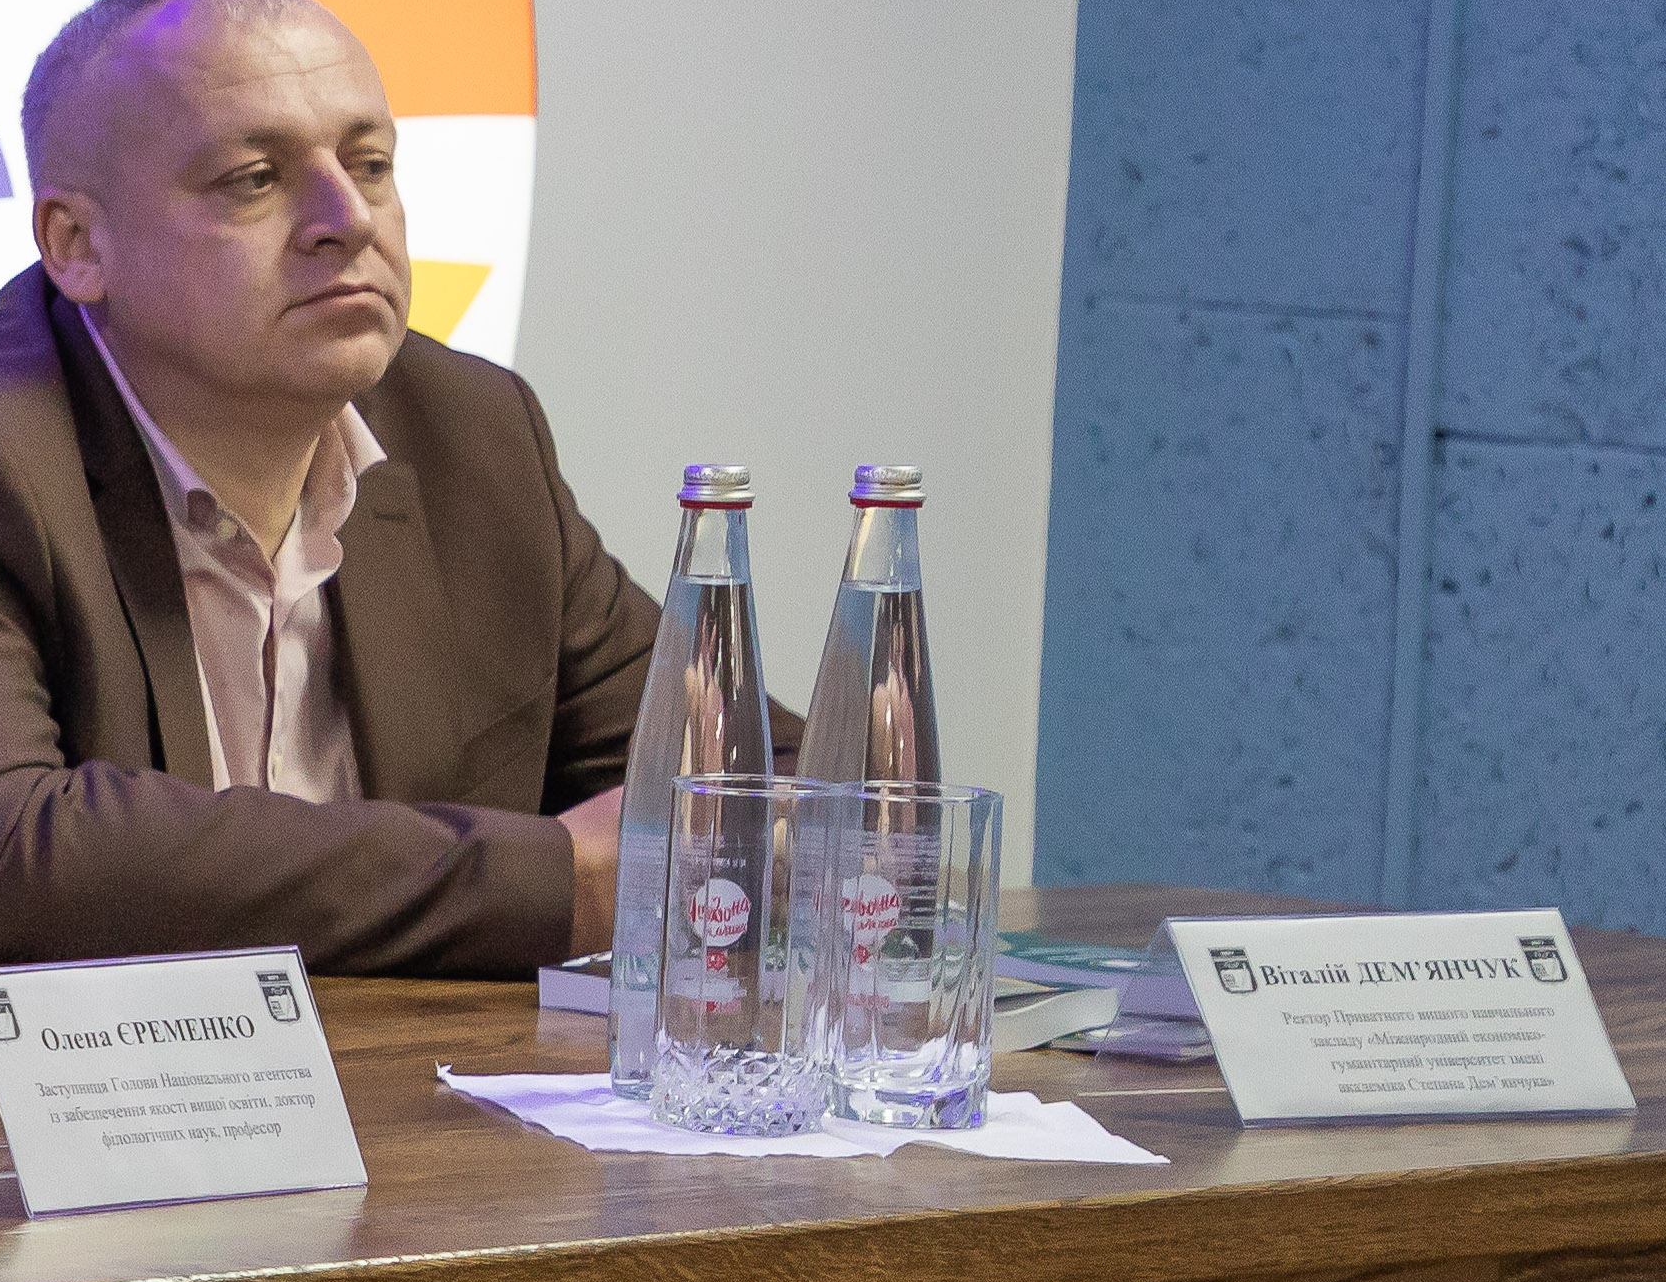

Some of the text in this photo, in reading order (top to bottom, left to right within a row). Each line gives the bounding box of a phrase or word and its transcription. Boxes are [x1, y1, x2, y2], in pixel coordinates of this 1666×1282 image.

[1259, 962, 1351, 987] Віталій
[41, 1015, 255, 1051] Олена ЄРЕМЕНКО
